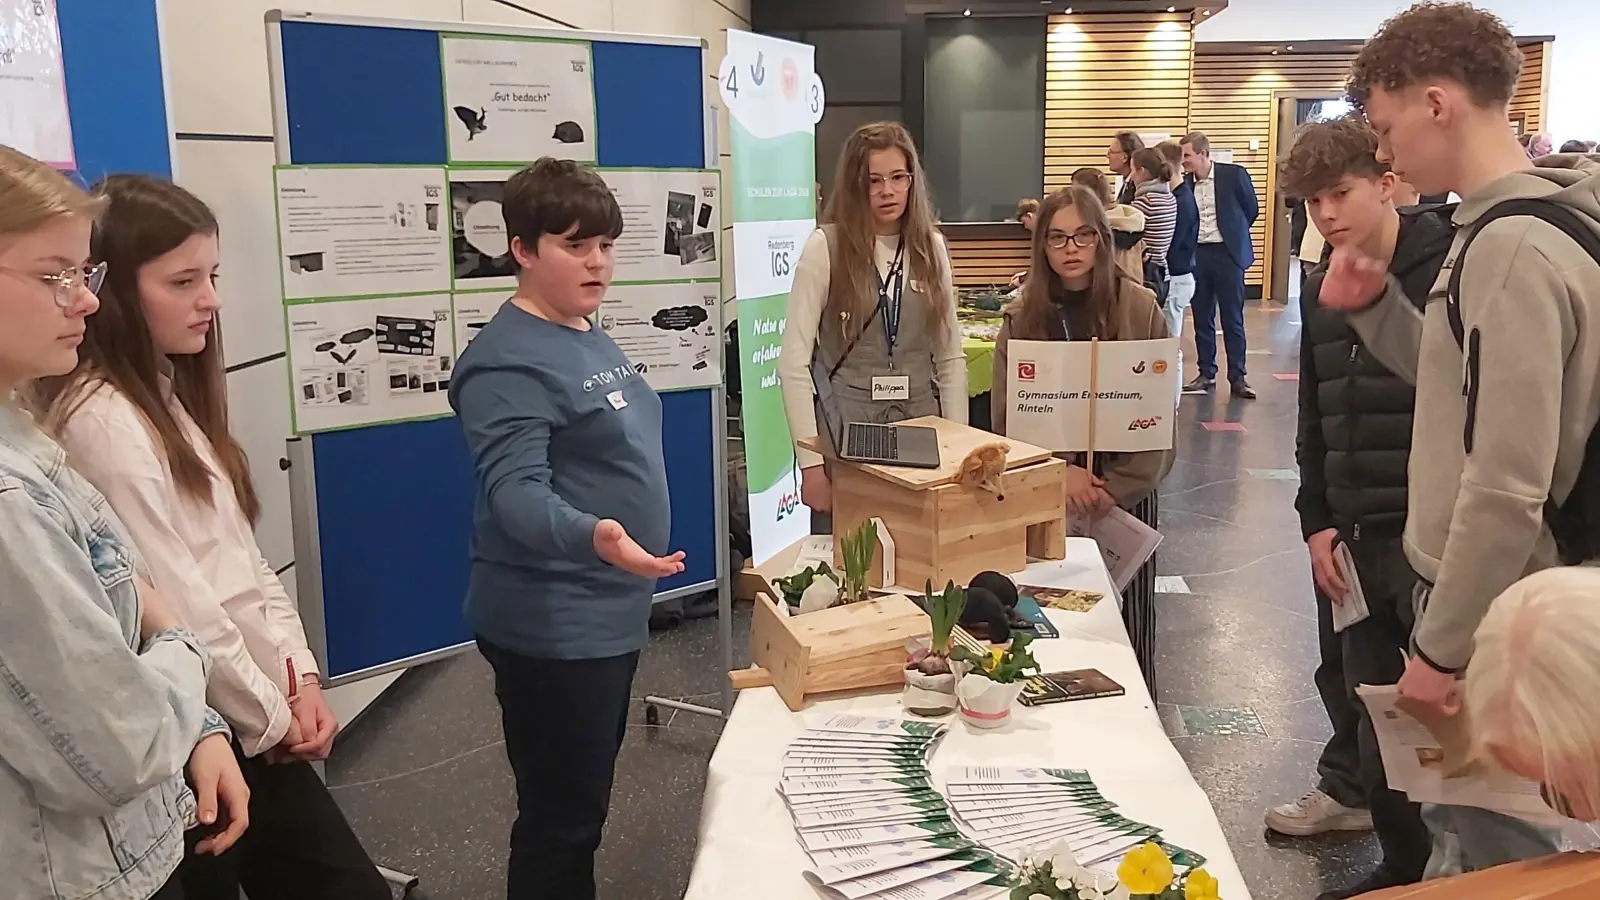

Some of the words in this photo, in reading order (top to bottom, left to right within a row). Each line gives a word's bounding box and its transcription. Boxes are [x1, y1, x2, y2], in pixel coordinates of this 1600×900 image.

[726, 65, 739, 98] 4
[810, 84, 819, 114] 3
[426, 188, 439, 198] IGS
[771, 251, 790, 277] IGS
[435, 312, 448, 321] IGS
[753, 317, 777, 336] Natur
[592, 370, 616, 386] TOM
[761, 367, 776, 389] und
[1017, 389, 1079, 401] Gymnasium
[1017, 403, 1054, 414] Rinteln
[1127, 417, 1157, 431] LAGA
[776, 492, 800, 522] LAGA
